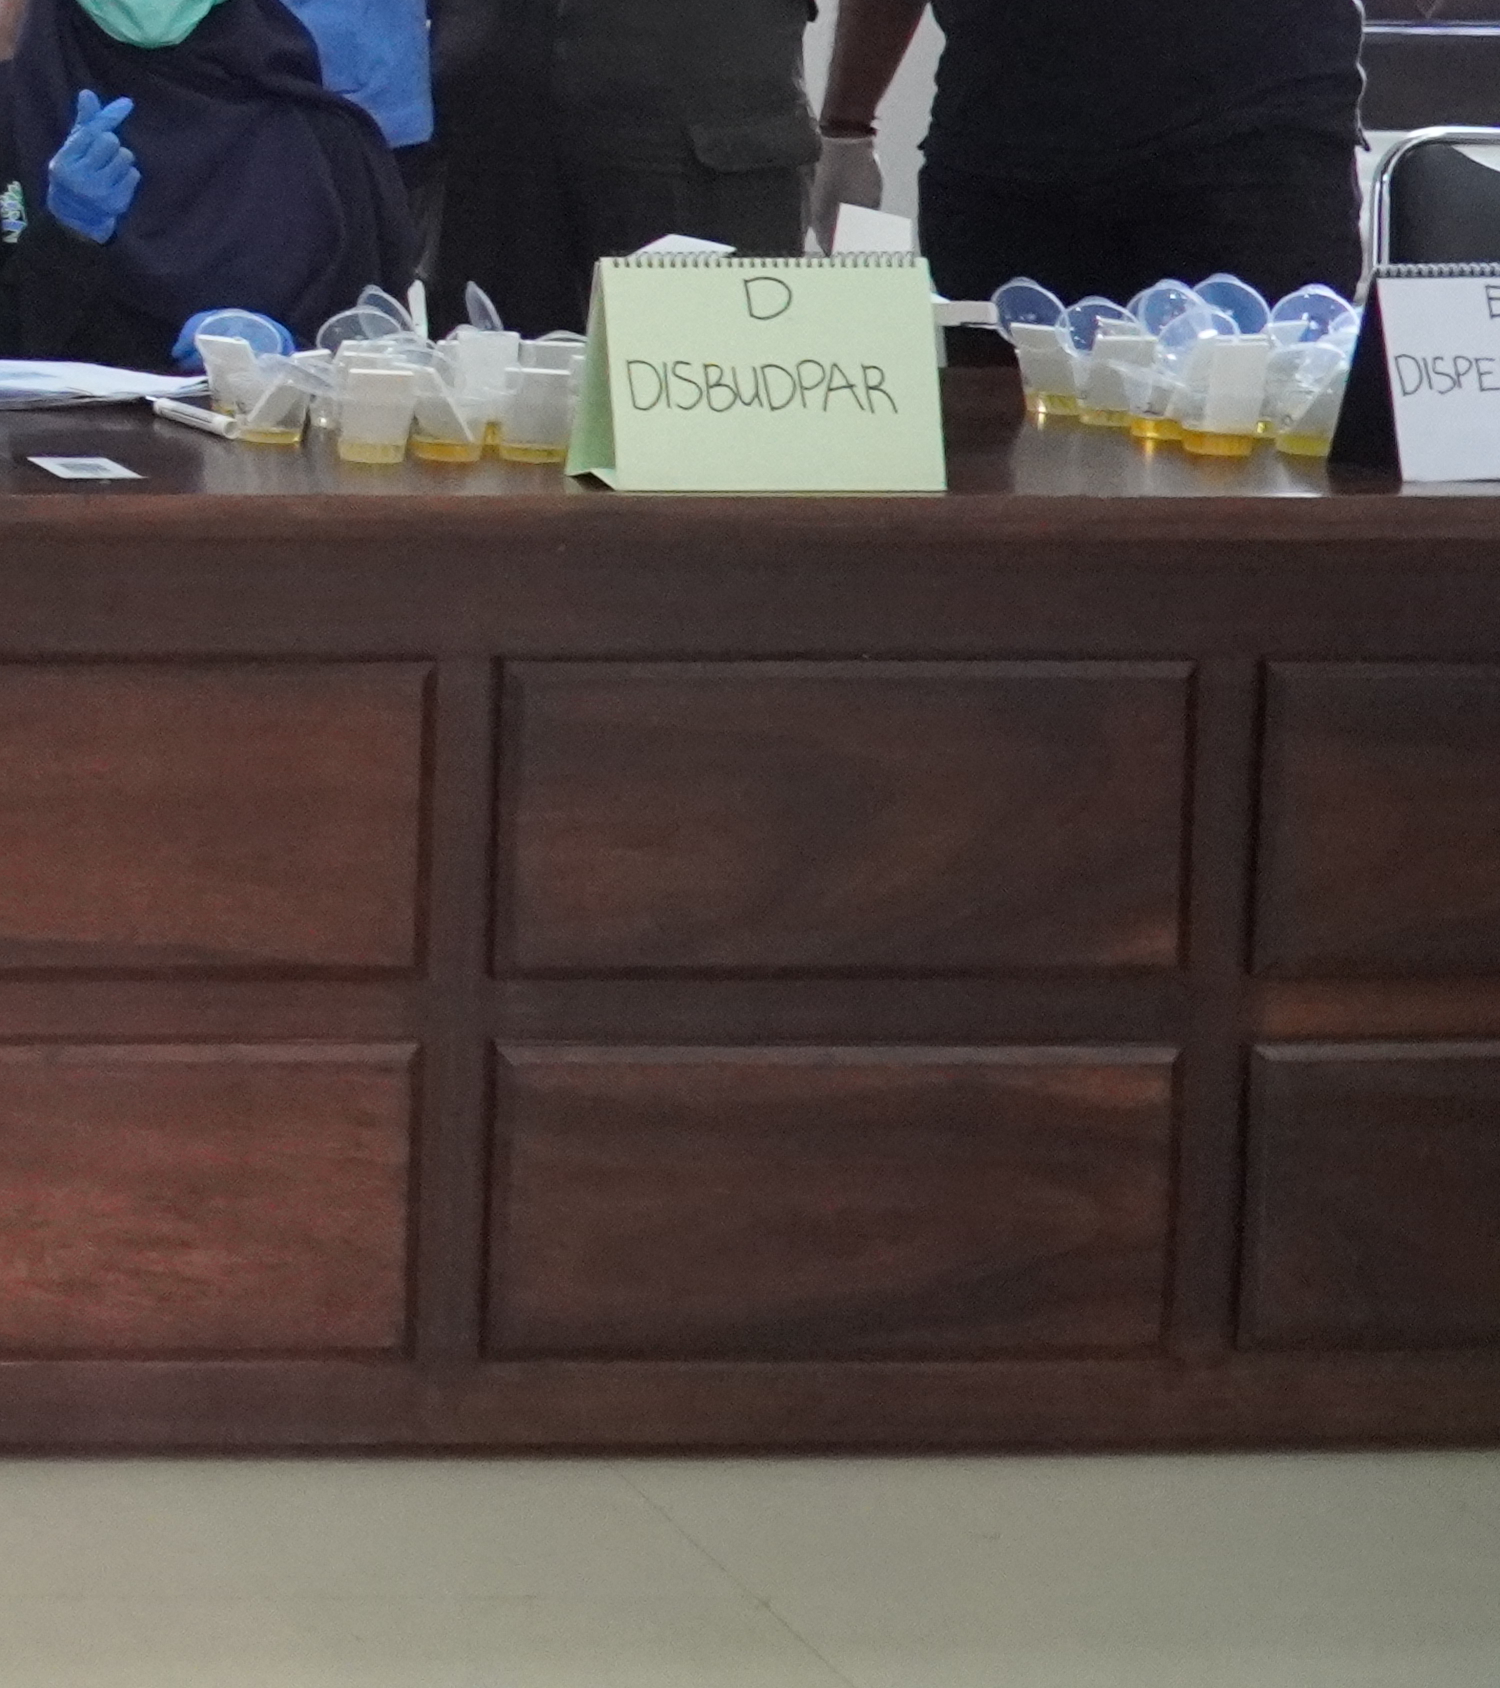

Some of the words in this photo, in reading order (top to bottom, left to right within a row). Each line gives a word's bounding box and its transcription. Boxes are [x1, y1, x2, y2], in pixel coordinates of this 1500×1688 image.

[743, 276, 792, 320] D
[626, 359, 899, 414] DISBUDPAR
[1394, 353, 1500, 397] DISPE
